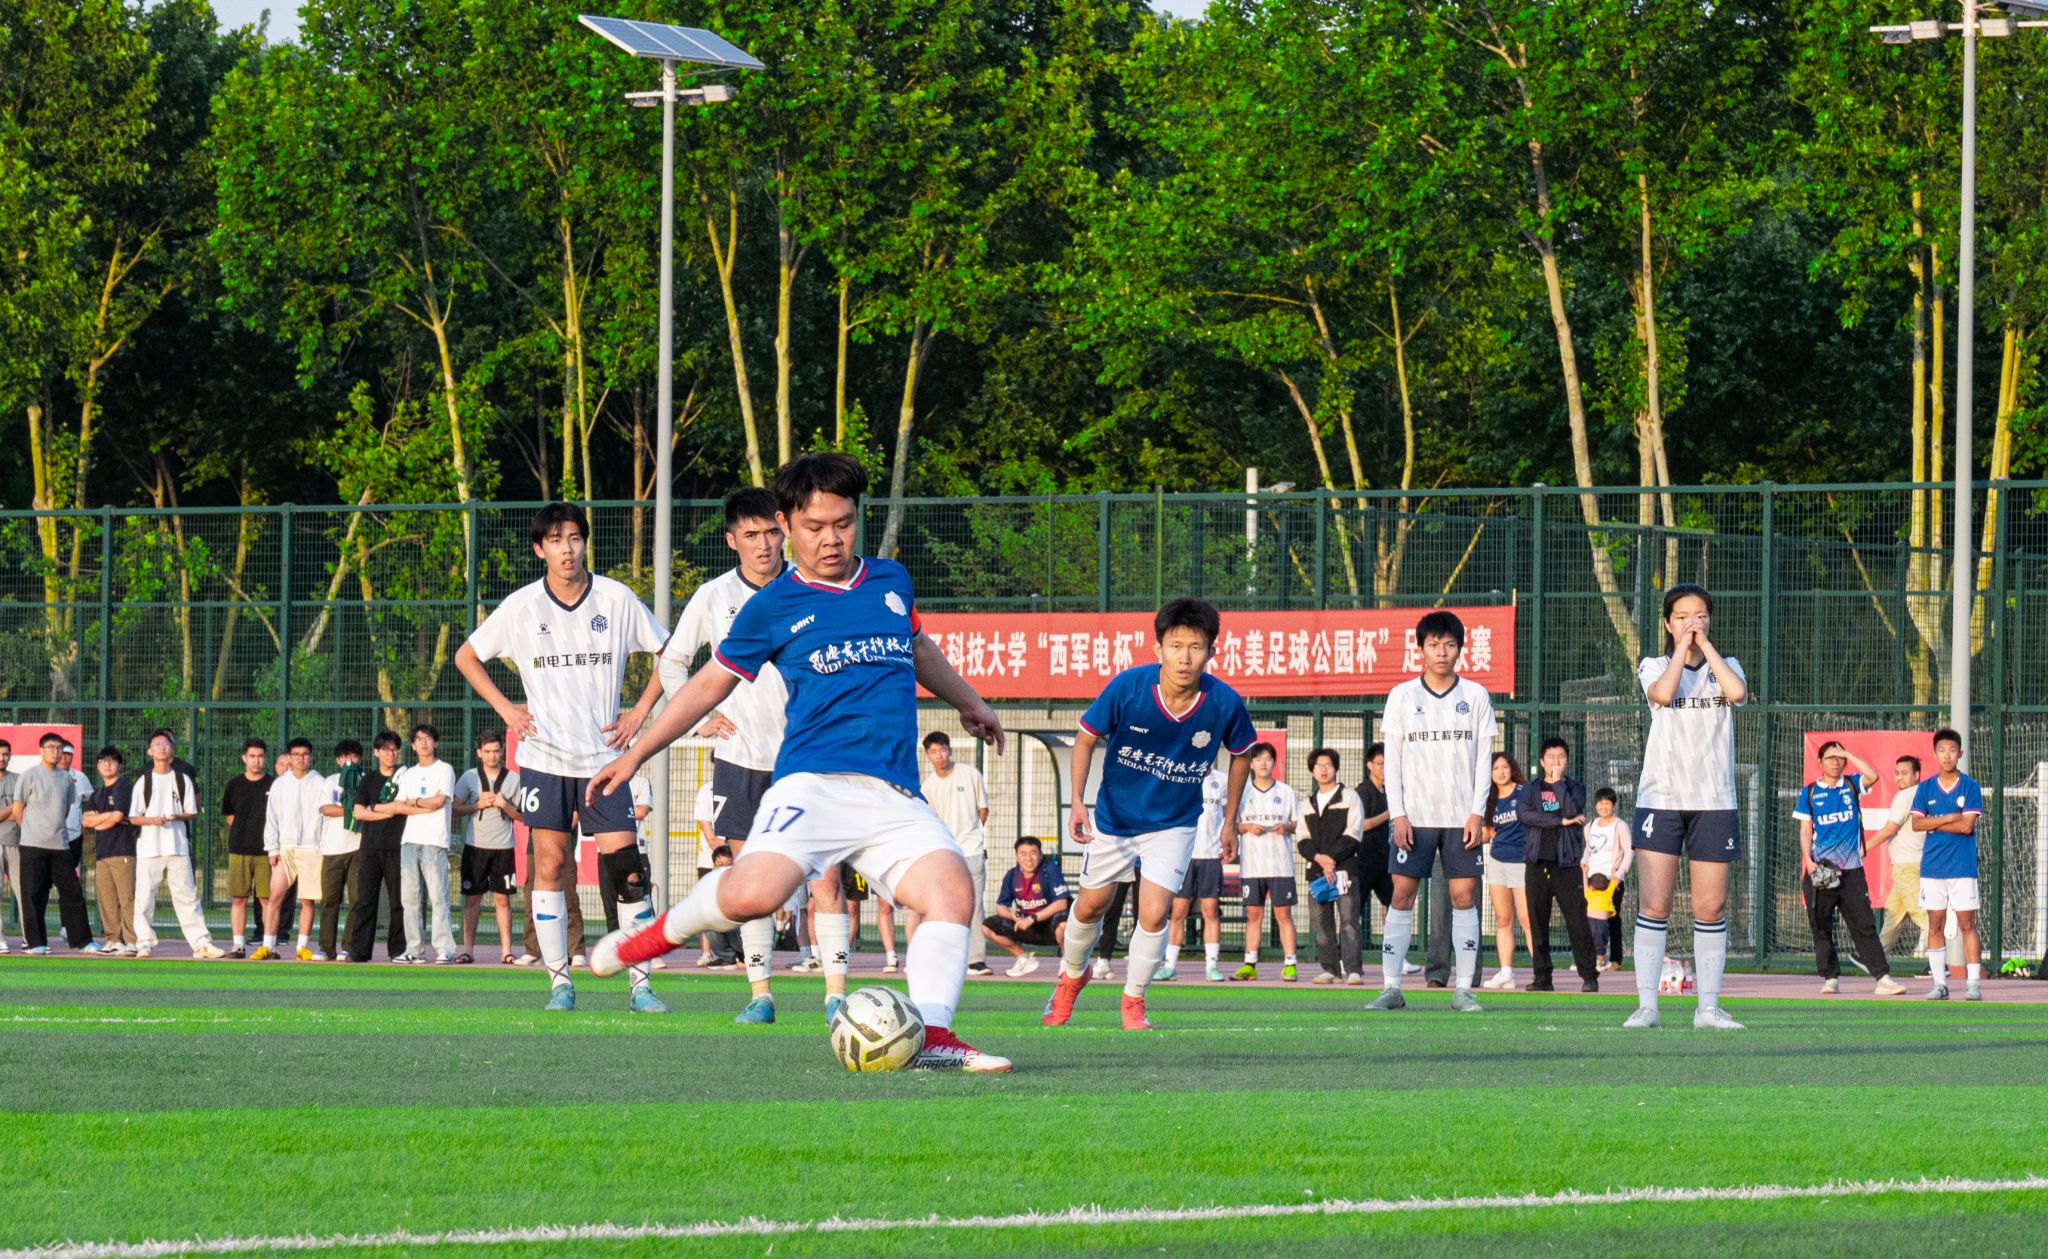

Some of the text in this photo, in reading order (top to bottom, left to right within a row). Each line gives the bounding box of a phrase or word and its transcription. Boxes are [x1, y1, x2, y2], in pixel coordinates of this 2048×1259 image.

[790, 614, 816, 633] ORKY
[533, 652, 613, 669] 机电工程学院
[1408, 730, 1473, 742] 机电工程学院
[1117, 757, 1202, 784] XIDIAN UNIVERSITY
[520, 786, 540, 812] 16
[762, 806, 805, 833] 17
[1641, 813, 1655, 838] 4
